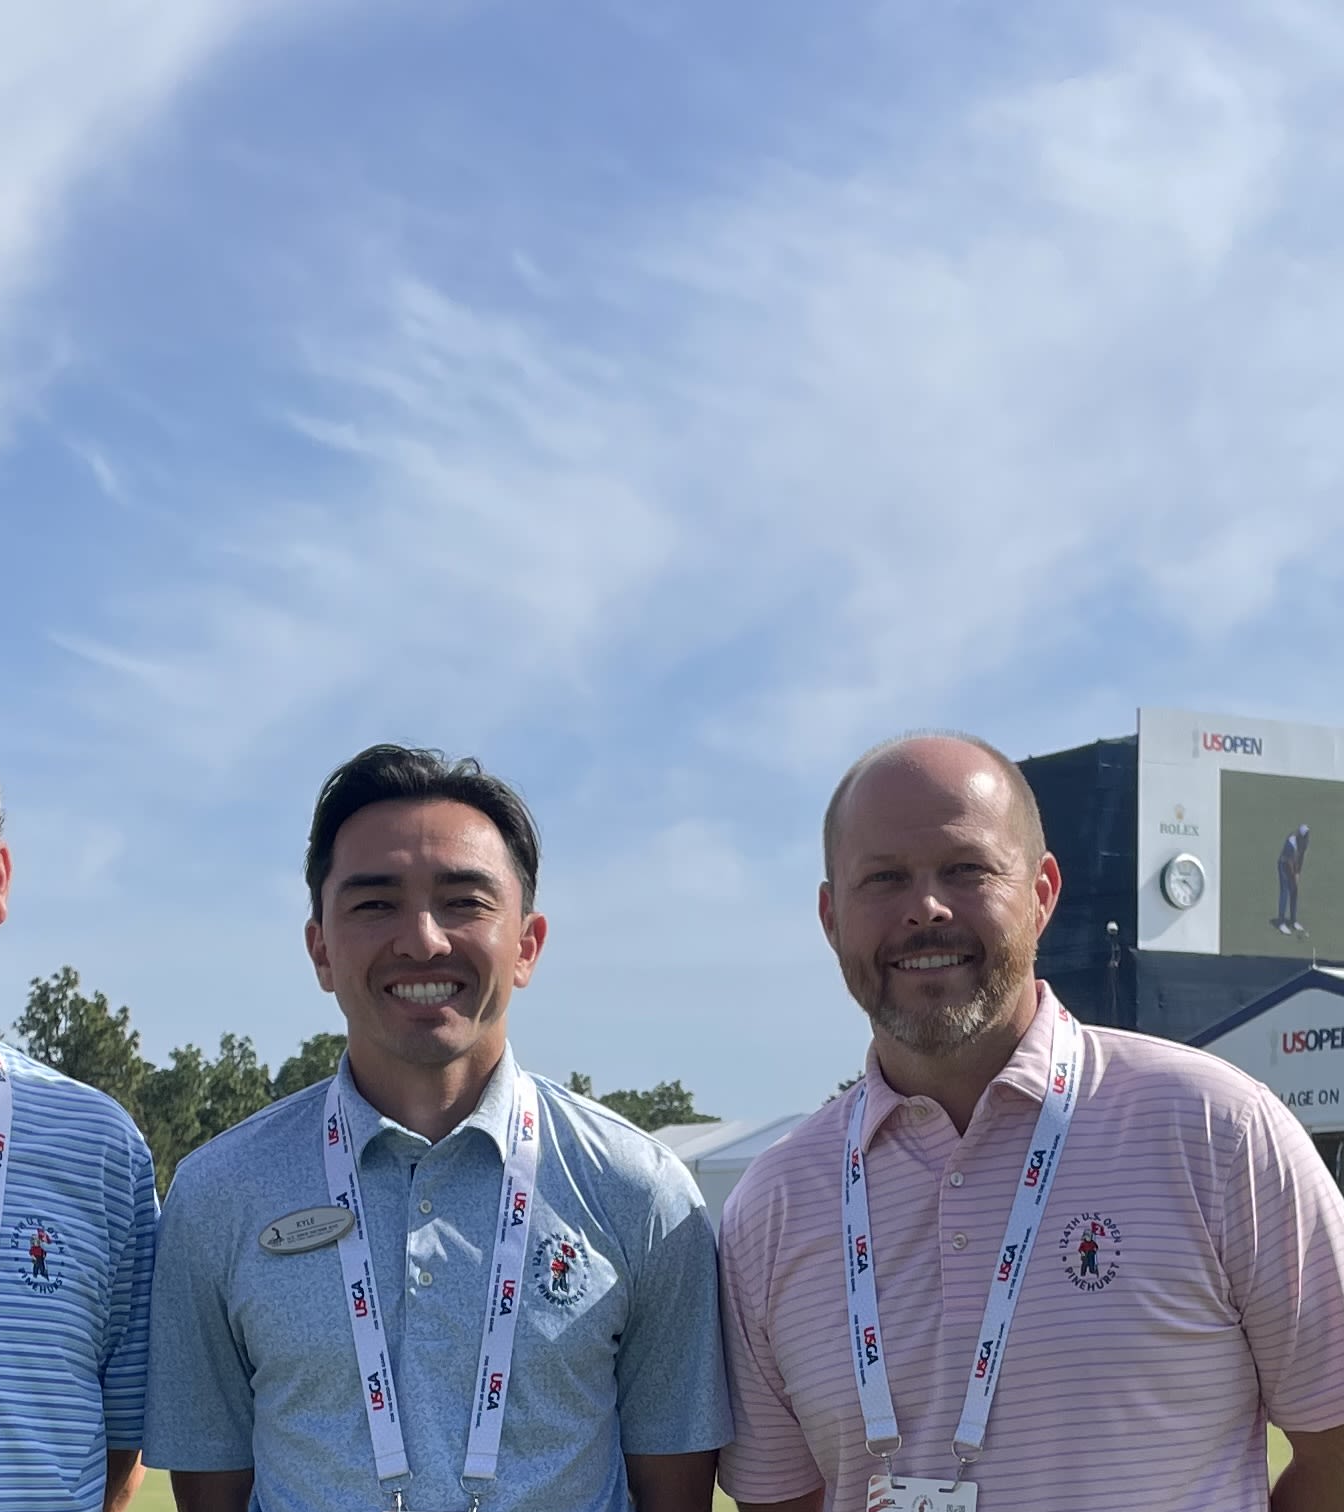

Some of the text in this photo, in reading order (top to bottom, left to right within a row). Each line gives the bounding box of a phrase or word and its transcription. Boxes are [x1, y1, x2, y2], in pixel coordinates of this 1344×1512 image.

[1203, 732, 1262, 756] USOPEN
[1160, 823, 1199, 836] ROLEX
[1052, 1064, 1067, 1095] USGA
[1319, 1088, 1339, 1105] ON
[328, 1113, 339, 1146] USGA
[521, 1111, 535, 1142] USGA
[852, 1147, 860, 1184] USGA
[1024, 1150, 1046, 1187] USGA
[296, 1217, 315, 1228] KYLE
[511, 1192, 526, 1227] USGA
[1059, 1212, 1122, 1248] 124TH U.S. OPEN
[856, 1235, 868, 1274] USGA
[997, 1244, 1018, 1281] USGA
[18, 1268, 64, 1294] PINEHURST
[1065, 1262, 1119, 1291] PINEHURST
[351, 1280, 367, 1317] USGA
[500, 1280, 515, 1316] USGA
[864, 1326, 878, 1366] USGA
[975, 1340, 993, 1378] USGA
[368, 1372, 384, 1410] USGA
[487, 1373, 503, 1410] USGA
